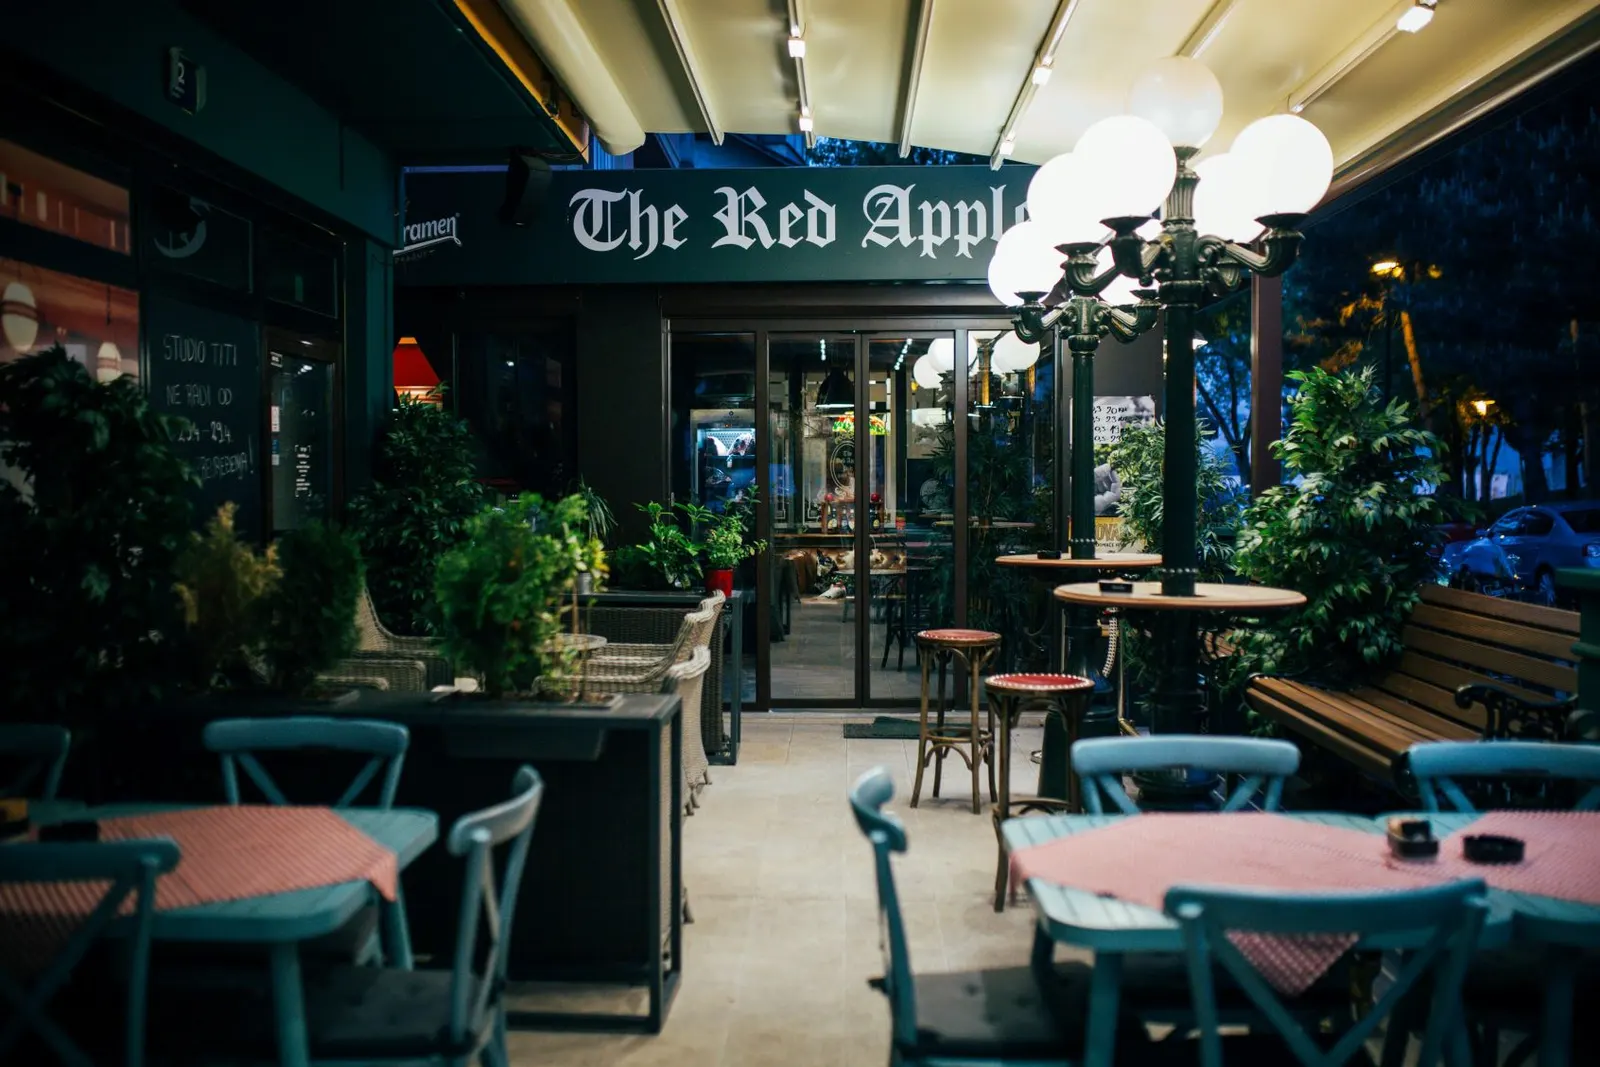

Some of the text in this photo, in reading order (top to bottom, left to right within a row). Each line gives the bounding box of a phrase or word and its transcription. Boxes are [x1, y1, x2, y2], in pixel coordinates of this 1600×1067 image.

[569, 187, 689, 260] The
[711, 186, 836, 250] Red
[162, 333, 238, 367] STUDIO TITI
[166, 383, 181, 406] NE
